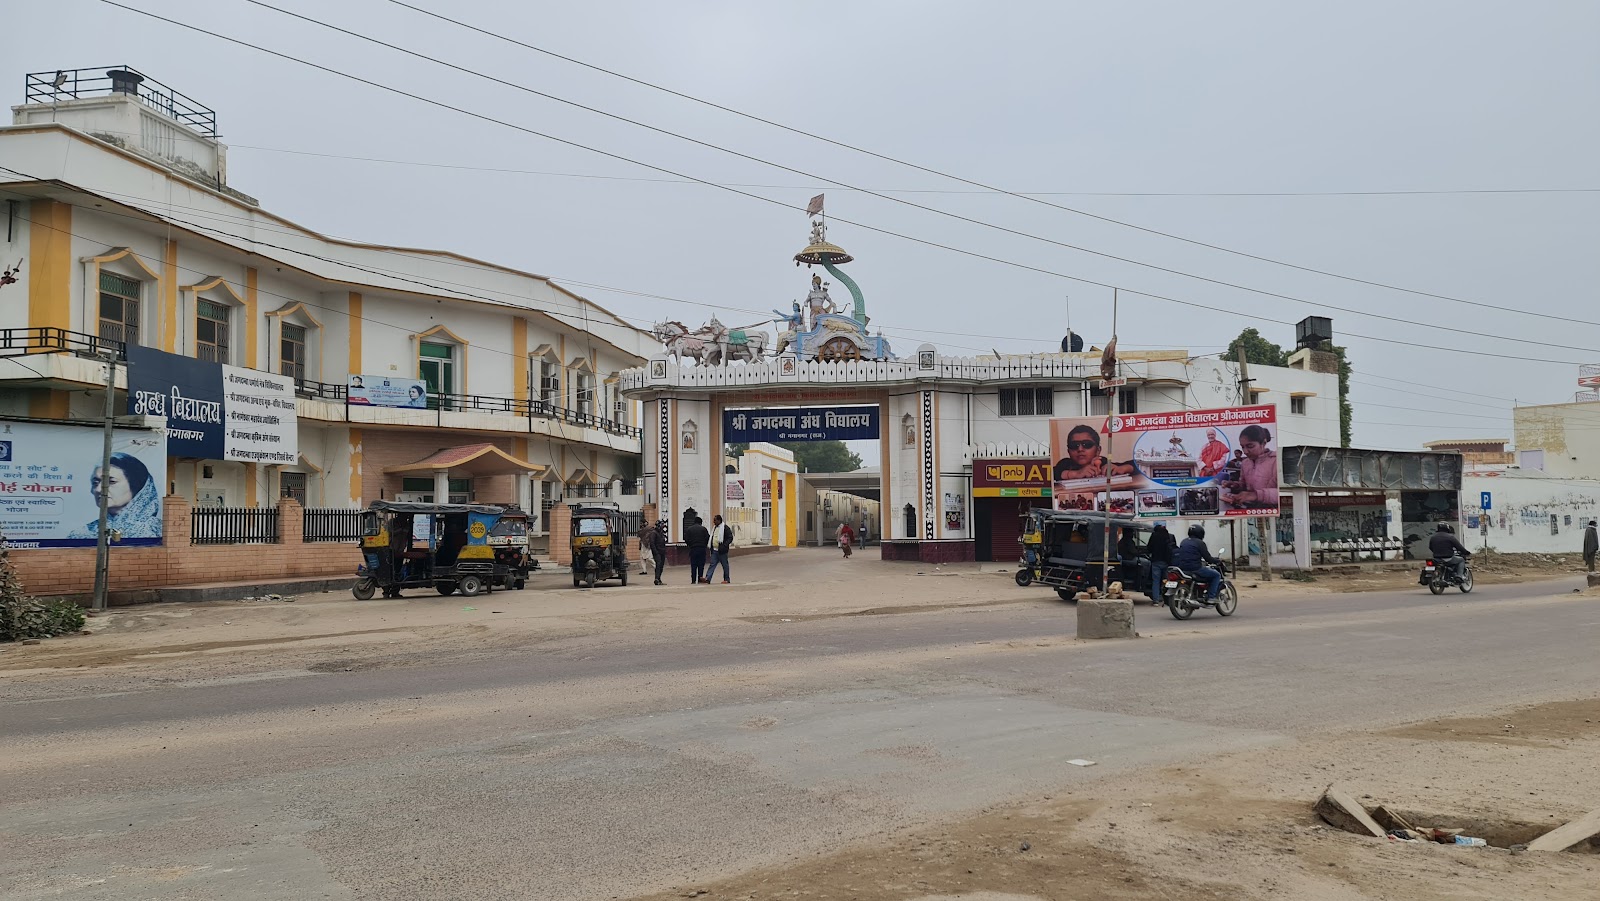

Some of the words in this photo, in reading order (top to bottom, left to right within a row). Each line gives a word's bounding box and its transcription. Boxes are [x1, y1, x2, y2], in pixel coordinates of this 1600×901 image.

[171, 386, 221, 424] विद्यालय
[732, 414, 746, 430] श्री
[752, 416, 796, 430] जगदम्बा
[801, 412, 820, 428] अंध
[826, 411, 870, 428] विद्यालय
[1126, 416, 1136, 428] श्री
[1138, 414, 1167, 426] जगदंबा
[1169, 413, 1184, 424] अंध
[1185, 412, 1219, 424] विद्यालय
[1220, 409, 1270, 422] श्रीगंगानगर
[1004, 467, 1022, 478] pnb
[1027, 465, 1051, 480] AT
[22, 482, 72, 493] योजना
[1484, 495, 1489, 506] P
